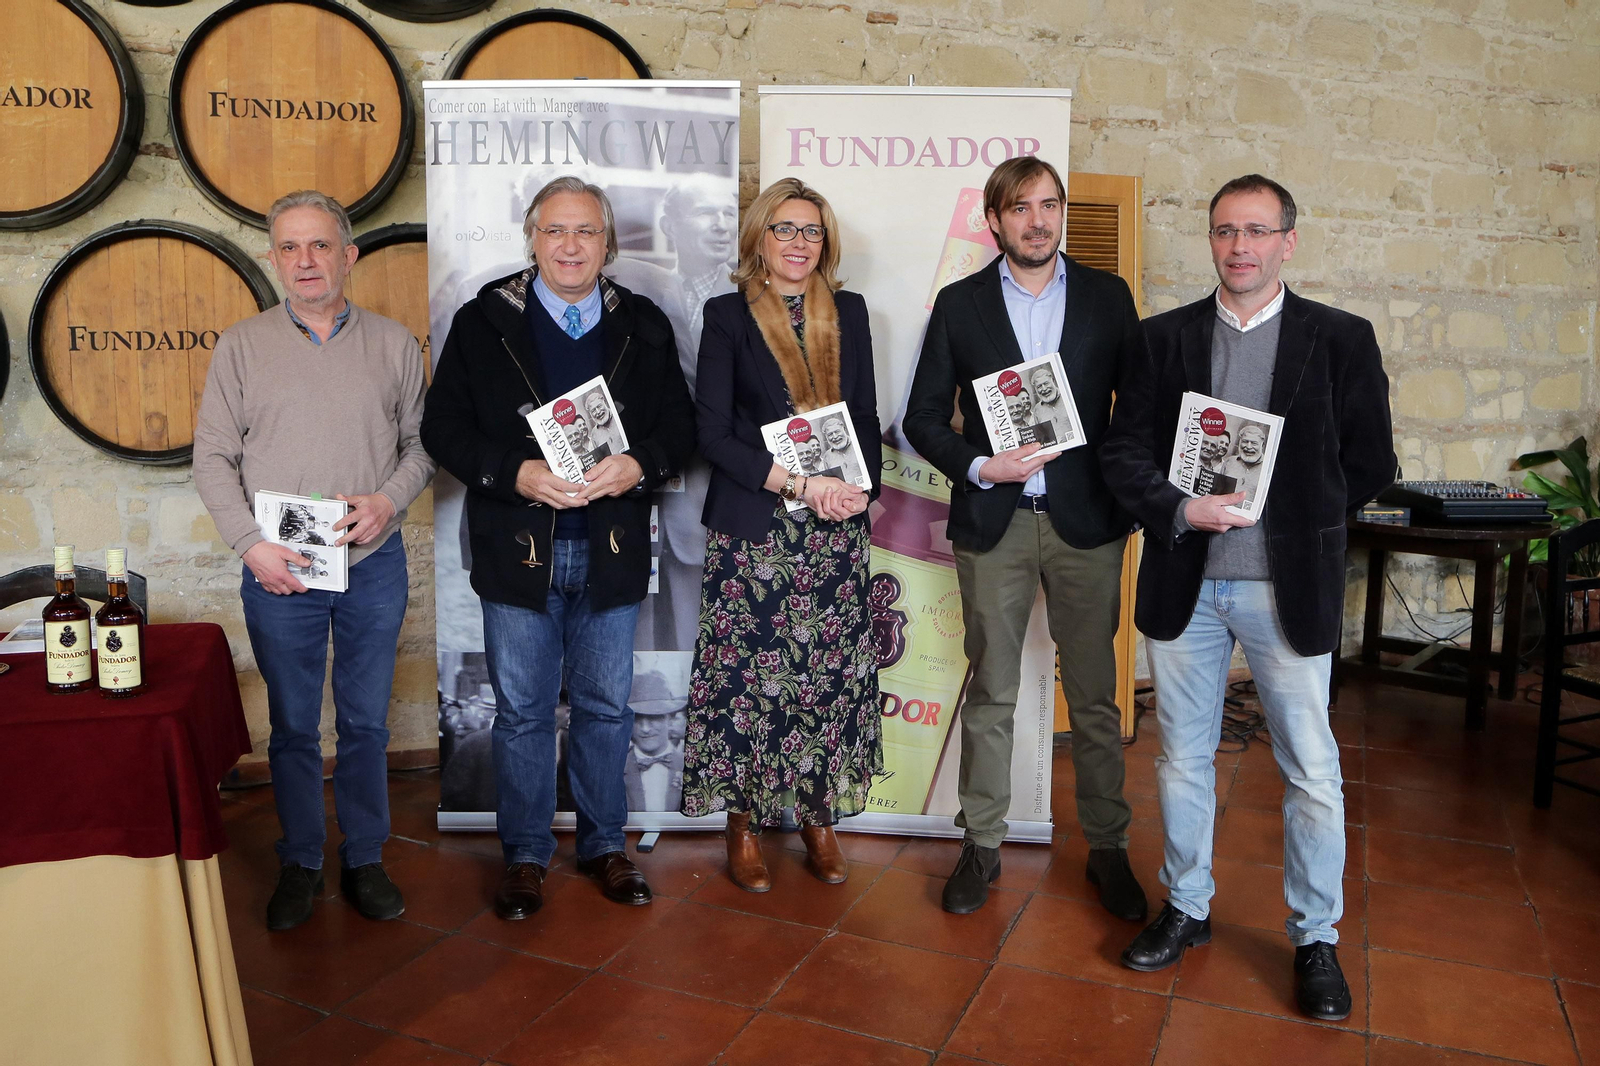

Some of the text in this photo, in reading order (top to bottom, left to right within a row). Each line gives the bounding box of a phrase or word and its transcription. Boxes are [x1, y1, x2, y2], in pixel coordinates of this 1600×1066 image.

[208, 91, 377, 122] FUNDADOR
[428, 97, 610, 118] Comer con Eat with Manger avec
[430, 120, 735, 166] HEMINGWAY
[786, 127, 1041, 168] FUNDADOR
[67, 325, 225, 352] FUNDADO
[1000, 376, 1019, 390] Winner
[554, 405, 573, 419] Winner
[1202, 418, 1223, 426] Winner
[789, 426, 809, 435] Winner
[777, 430, 801, 476] NGWAY
[1180, 406, 1203, 490] HEMINGWAY
[49, 650, 90, 659] FUNDADOR
[919, 654, 949, 666] PRODUCE
[928, 664, 946, 673] SPAIN
[879, 691, 942, 726] DOR
[1033, 674, 1048, 814] Disfrute de un consumo responsable
[867, 796, 898, 809] EREZ
